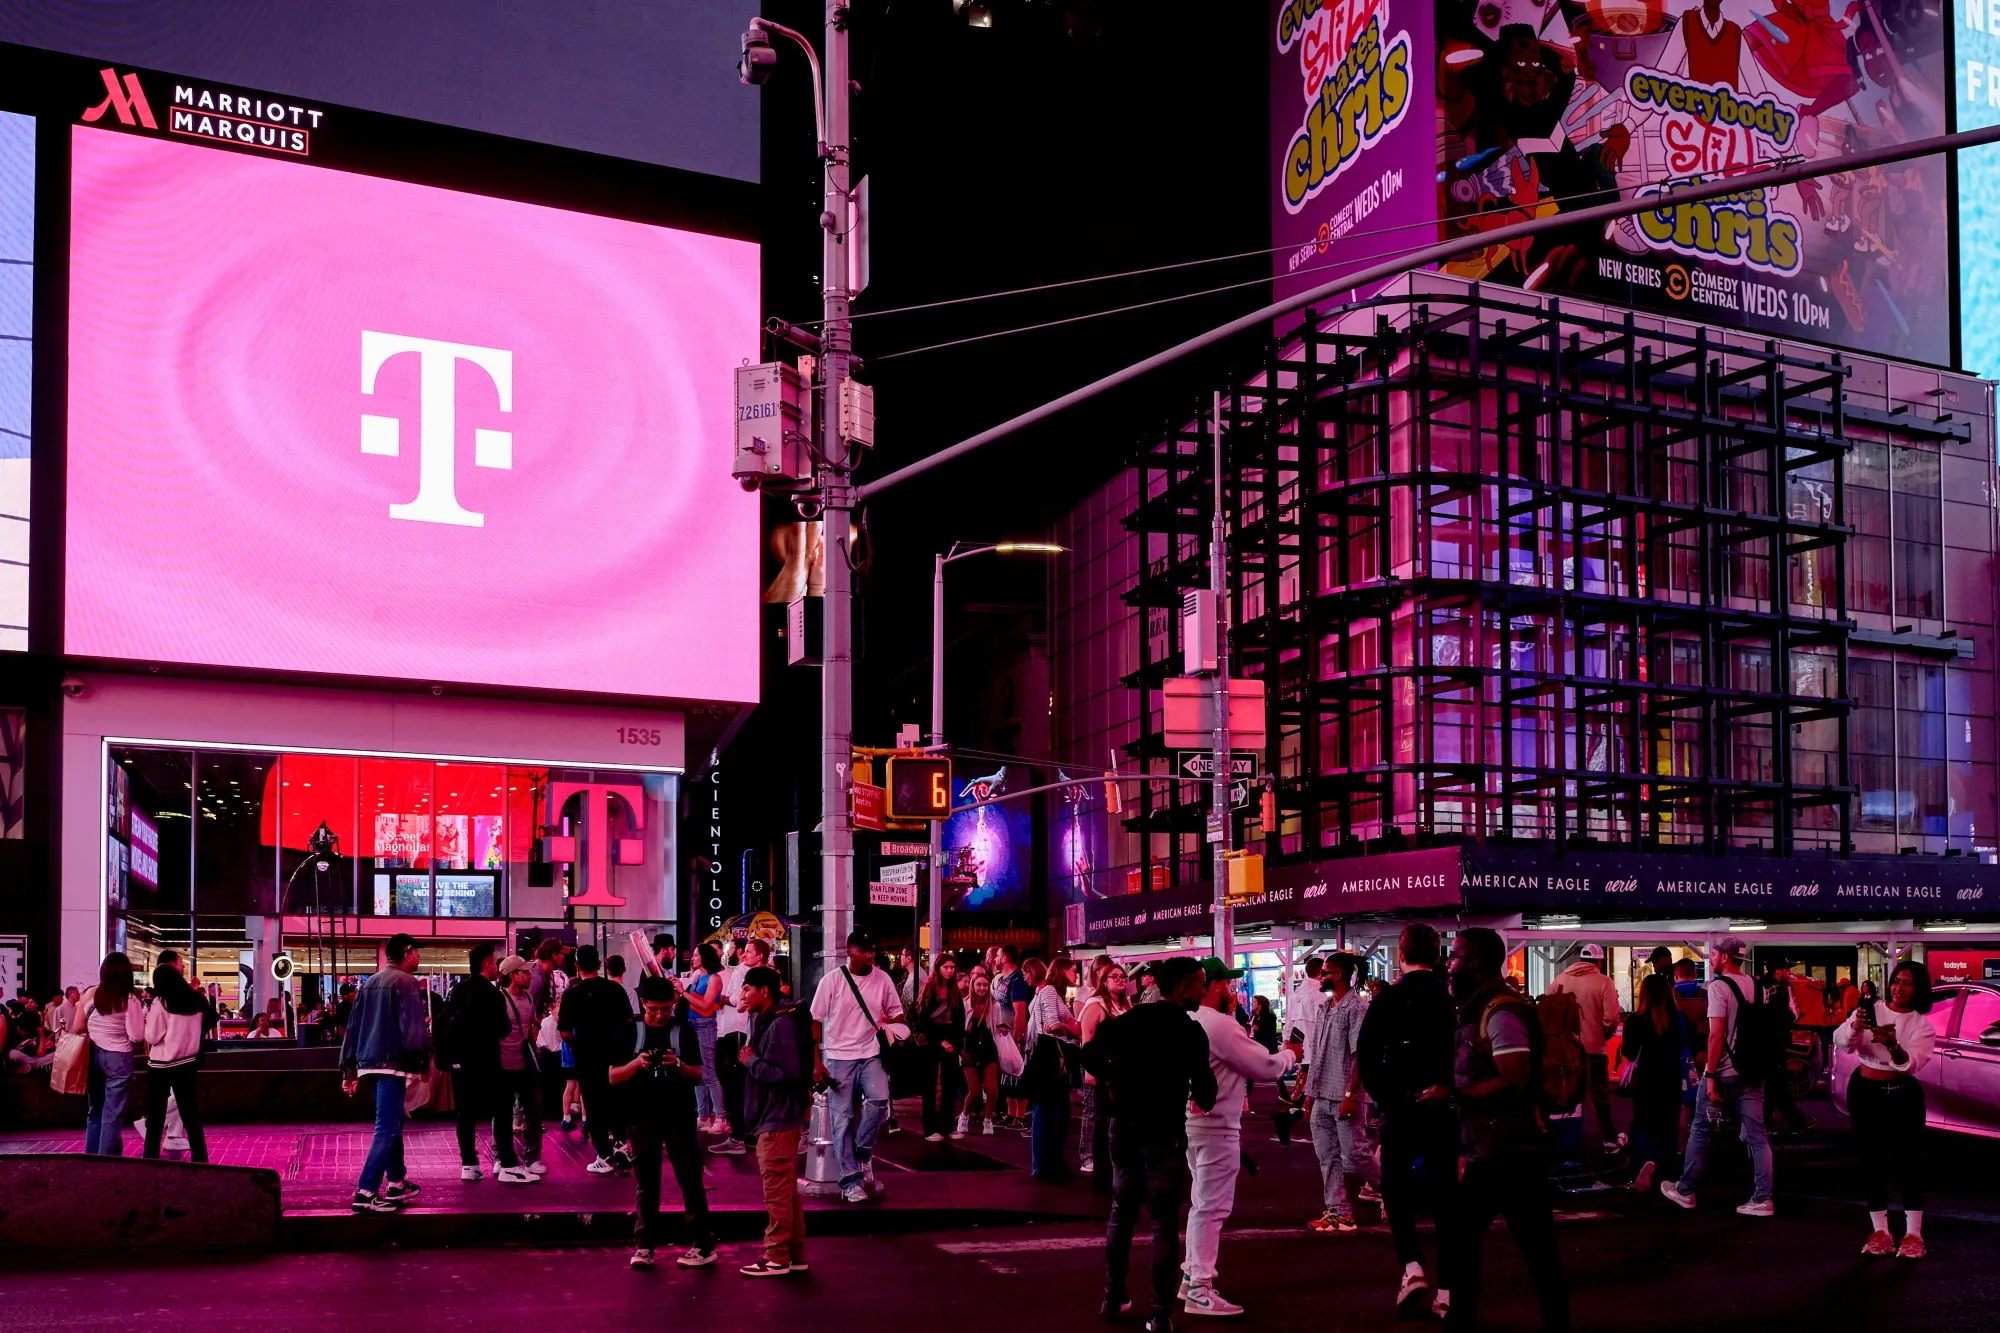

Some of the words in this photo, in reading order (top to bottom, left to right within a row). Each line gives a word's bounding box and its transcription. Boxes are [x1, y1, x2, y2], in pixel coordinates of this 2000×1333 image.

[174, 85, 323, 128] MARRIOTT
[1630, 72, 1795, 145] everybody
[174, 111, 305, 151] MARQUIS
[1354, 180, 1380, 223] WEDS
[1381, 168, 1403, 202] 10PM
[1329, 201, 1354, 231] COMEDY
[1330, 216, 1354, 244] CENTRAL
[1289, 251, 1300, 273] NEW
[1300, 238, 1317, 264] SERIES
[1598, 257, 1622, 281] NEW
[1625, 263, 1662, 289] SERIES
[1691, 270, 1739, 294] COMEDY
[1691, 286, 1740, 311] CENTRAL
[1741, 280, 1788, 321] WEDS
[1792, 293, 1830, 330] 10PM
[361, 329, 513, 528] T
[616, 727, 661, 746] 1535
[1191, 760, 1213, 772] ONE
[1231, 761, 1247, 772] AY
[932, 772, 946, 808] 6
[892, 844, 928, 857] Broadway
[413, 888, 443, 897] WOD
[444, 889, 476, 897] BEHIND
[452, 881, 469, 889] THE
[882, 886, 895, 894] FLOW
[895, 887, 908, 895] ZONE
[890, 895, 908, 903] MOVING
[1460, 874, 1538, 889] AMERICAN
[1547, 878, 1590, 891] EAGLE
[1605, 875, 1638, 893] aerie
[1657, 880, 1726, 894] AMERICAN
[1734, 883, 1773, 895] EAGLE
[1789, 880, 1819, 897] aerie
[1837, 885, 1900, 897] AMERICAN
[1906, 886, 1941, 898] EAGLE
[1956, 883, 1983, 900] aerie
[1089, 919, 1113, 931] AMERICAN
[1115, 916, 1130, 927] EAGLE
[1153, 907, 1182, 921] AMERICAN
[1184, 904, 1202, 916] EAGLE
[1269, 888, 1293, 903] EAGLE
[1303, 879, 1328, 899] aerie
[1341, 877, 1400, 894] AMERICAN
[1407, 874, 1445, 889] EAGLE
